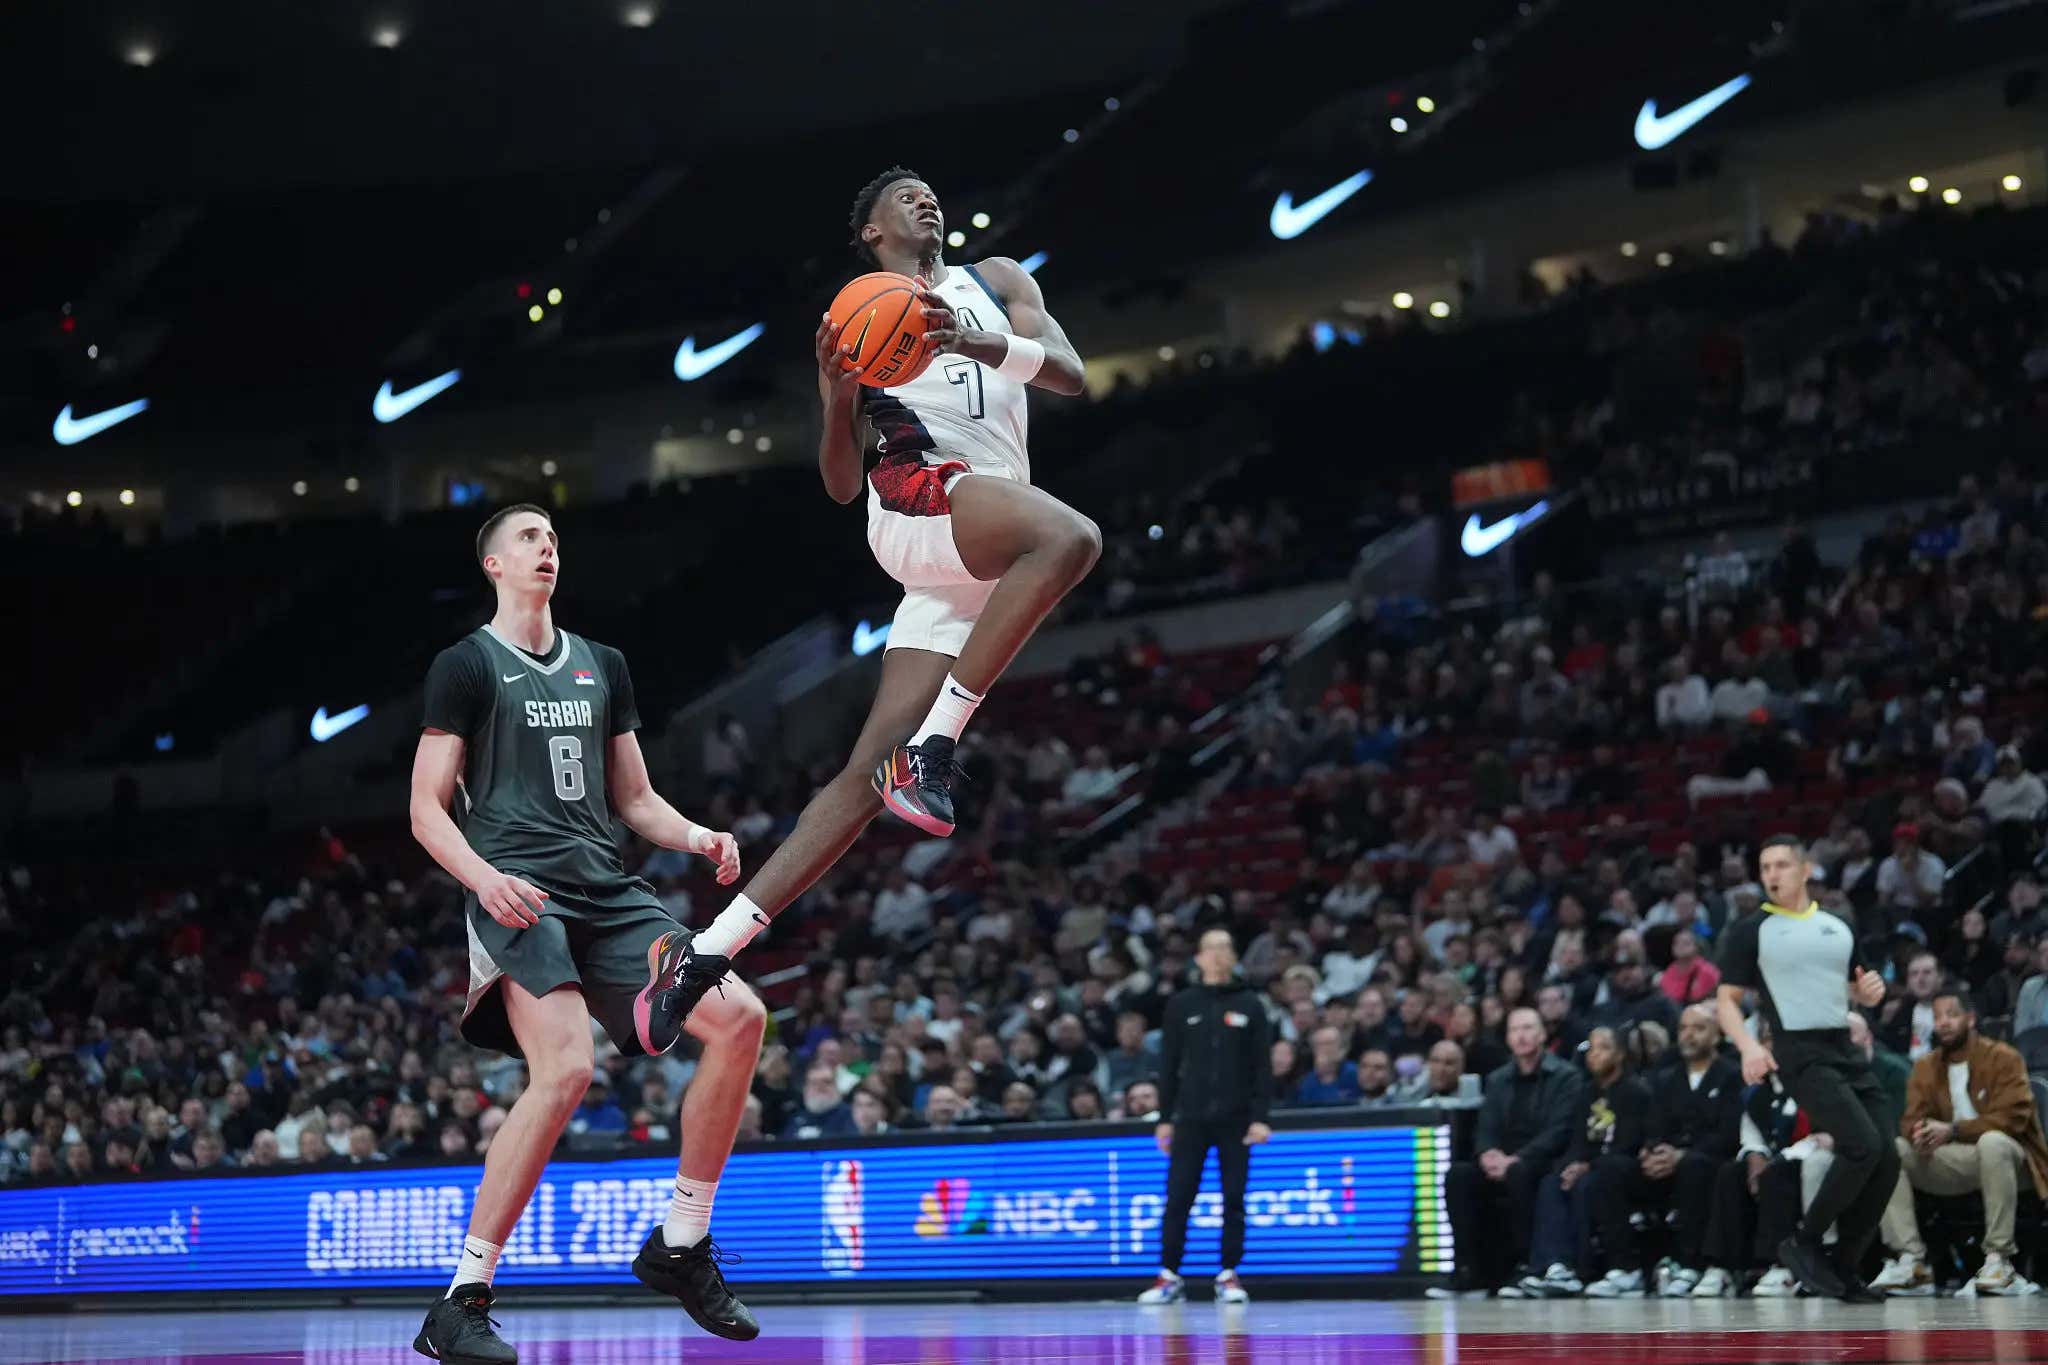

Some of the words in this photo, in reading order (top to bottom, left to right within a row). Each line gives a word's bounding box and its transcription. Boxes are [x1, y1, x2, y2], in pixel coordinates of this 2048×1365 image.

[873, 332, 917, 382] ELITE
[944, 361, 985, 420] 7
[525, 700, 594, 728] SERBIA
[548, 735, 586, 801] 6
[993, 1188, 1098, 1237] NBC
[1129, 1167, 1339, 1254] paock
